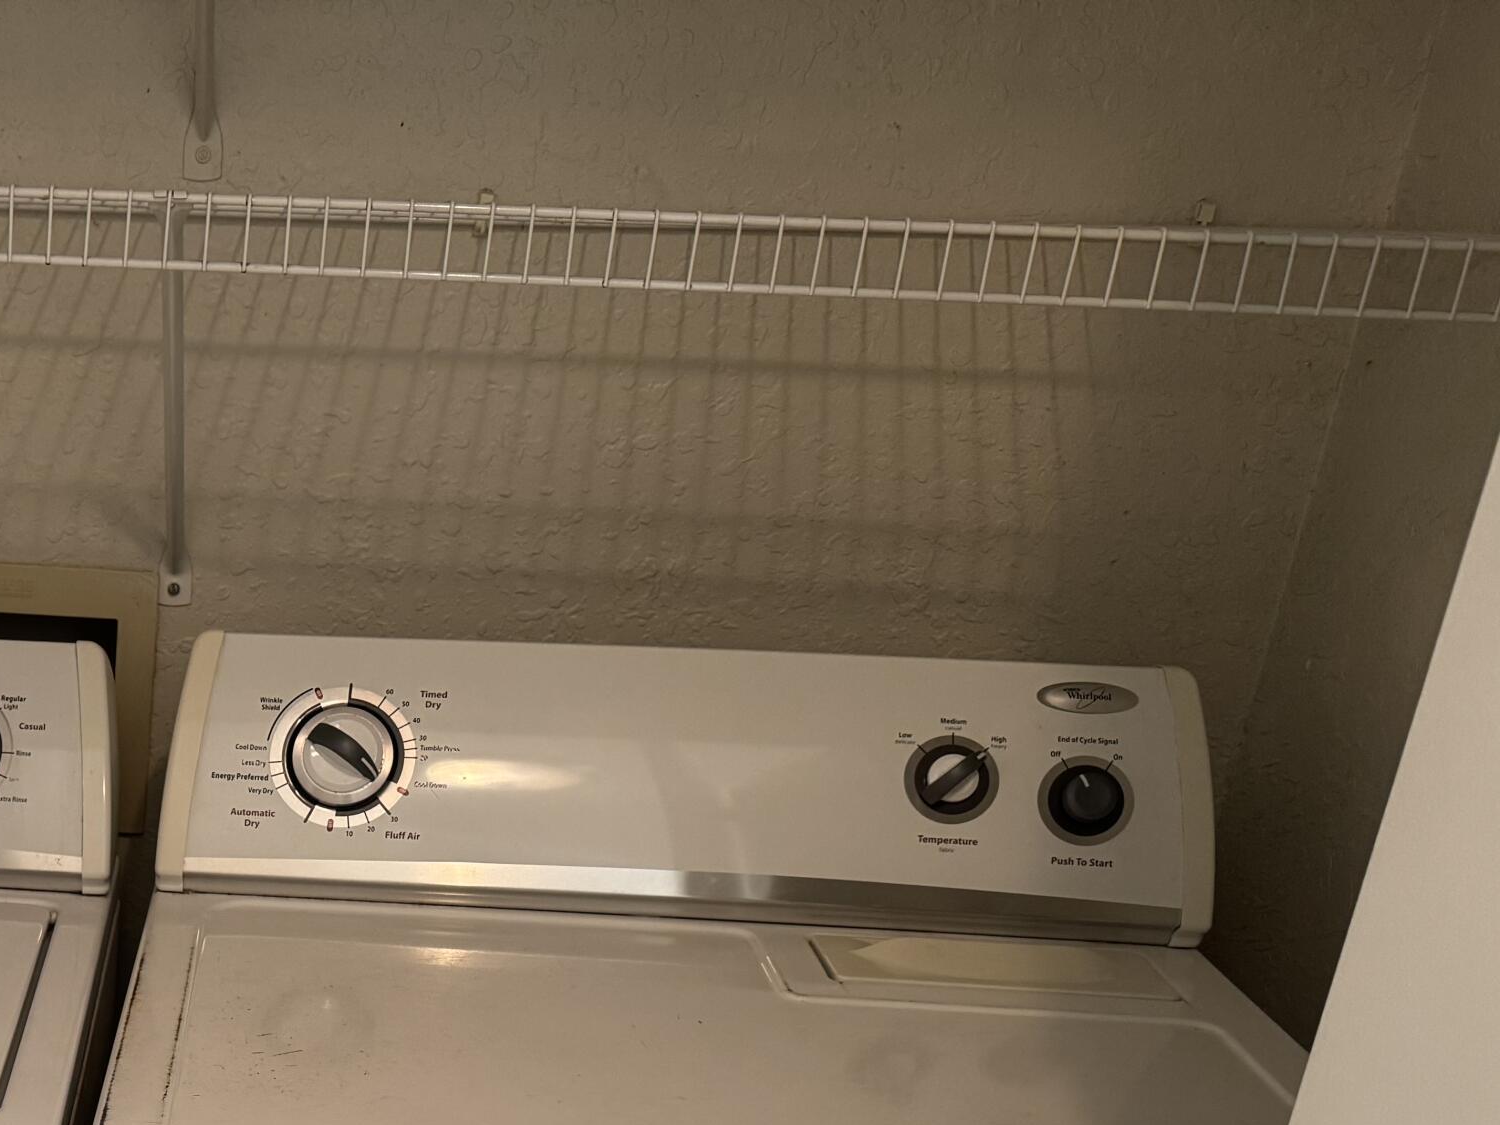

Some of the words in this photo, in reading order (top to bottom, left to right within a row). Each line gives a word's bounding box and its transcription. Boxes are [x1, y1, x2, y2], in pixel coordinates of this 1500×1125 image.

[420, 690, 448, 699] Timed
[1066, 690, 1112, 702] Whirlpool
[0, 695, 26, 704] Regular
[425, 701, 442, 710] Dry
[18, 722, 46, 732] Casual
[990, 736, 1008, 744] High
[1079, 737, 1096, 745] Cycle
[1098, 738, 1118, 746] Signal
[211, 772, 235, 782] Energy
[236, 773, 269, 782] Preferred
[248, 788, 262, 796] Very
[262, 788, 274, 796] Dry
[230, 808, 276, 818] Automatic
[244, 819, 260, 829] Dry
[385, 832, 405, 840] Fluff
[406, 832, 420, 841] Air
[918, 835, 978, 847] Temperature
[1051, 857, 1074, 866] Push
[1076, 858, 1088, 866] To
[1089, 858, 1113, 868] Start
